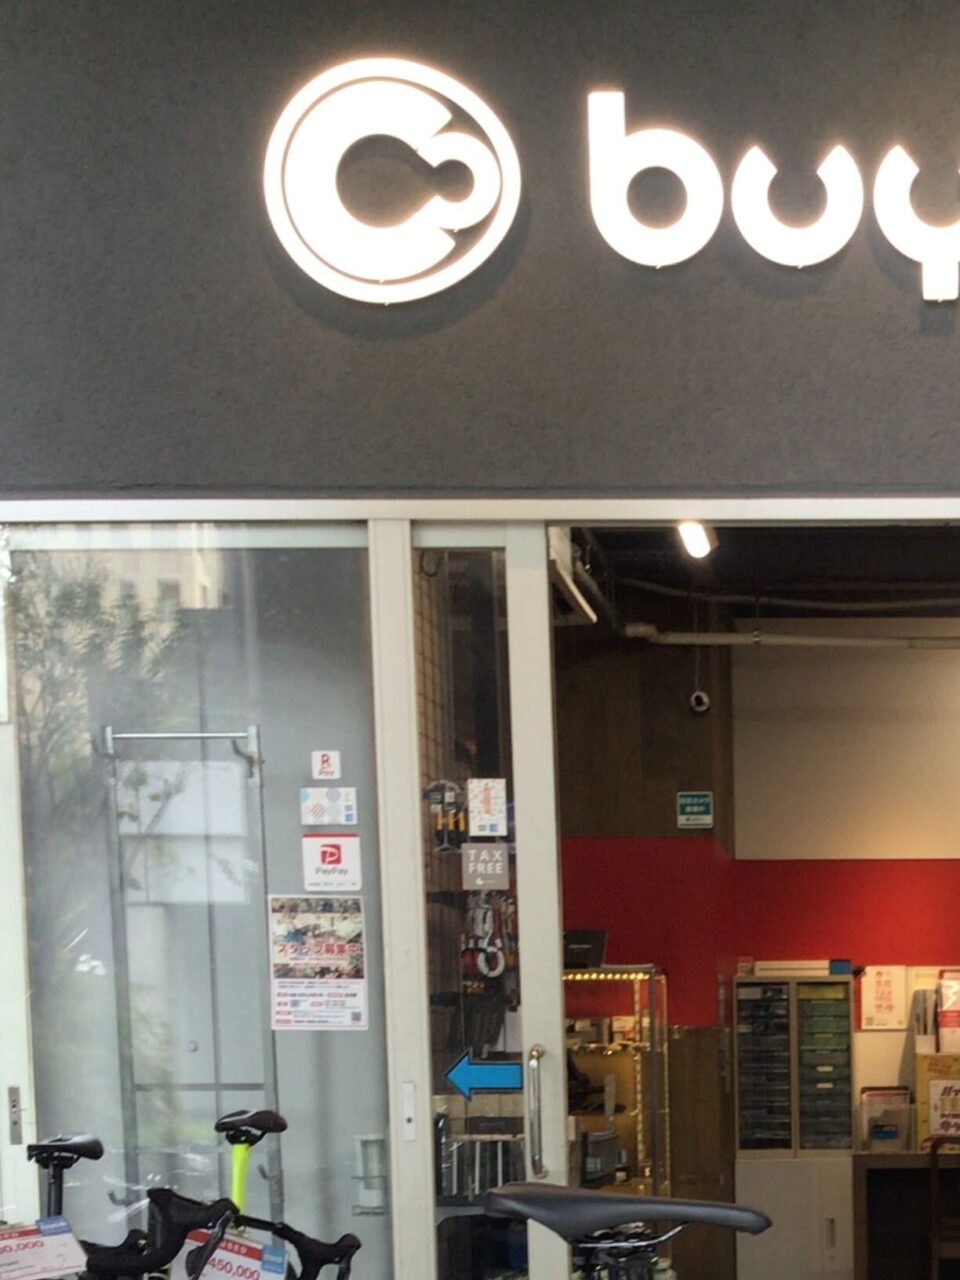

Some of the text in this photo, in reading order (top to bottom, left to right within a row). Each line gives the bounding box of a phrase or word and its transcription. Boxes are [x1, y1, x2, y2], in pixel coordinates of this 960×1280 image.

[468, 850, 503, 861] TAX
[315, 867, 348, 877] PayPay
[468, 863, 504, 874] FREE
